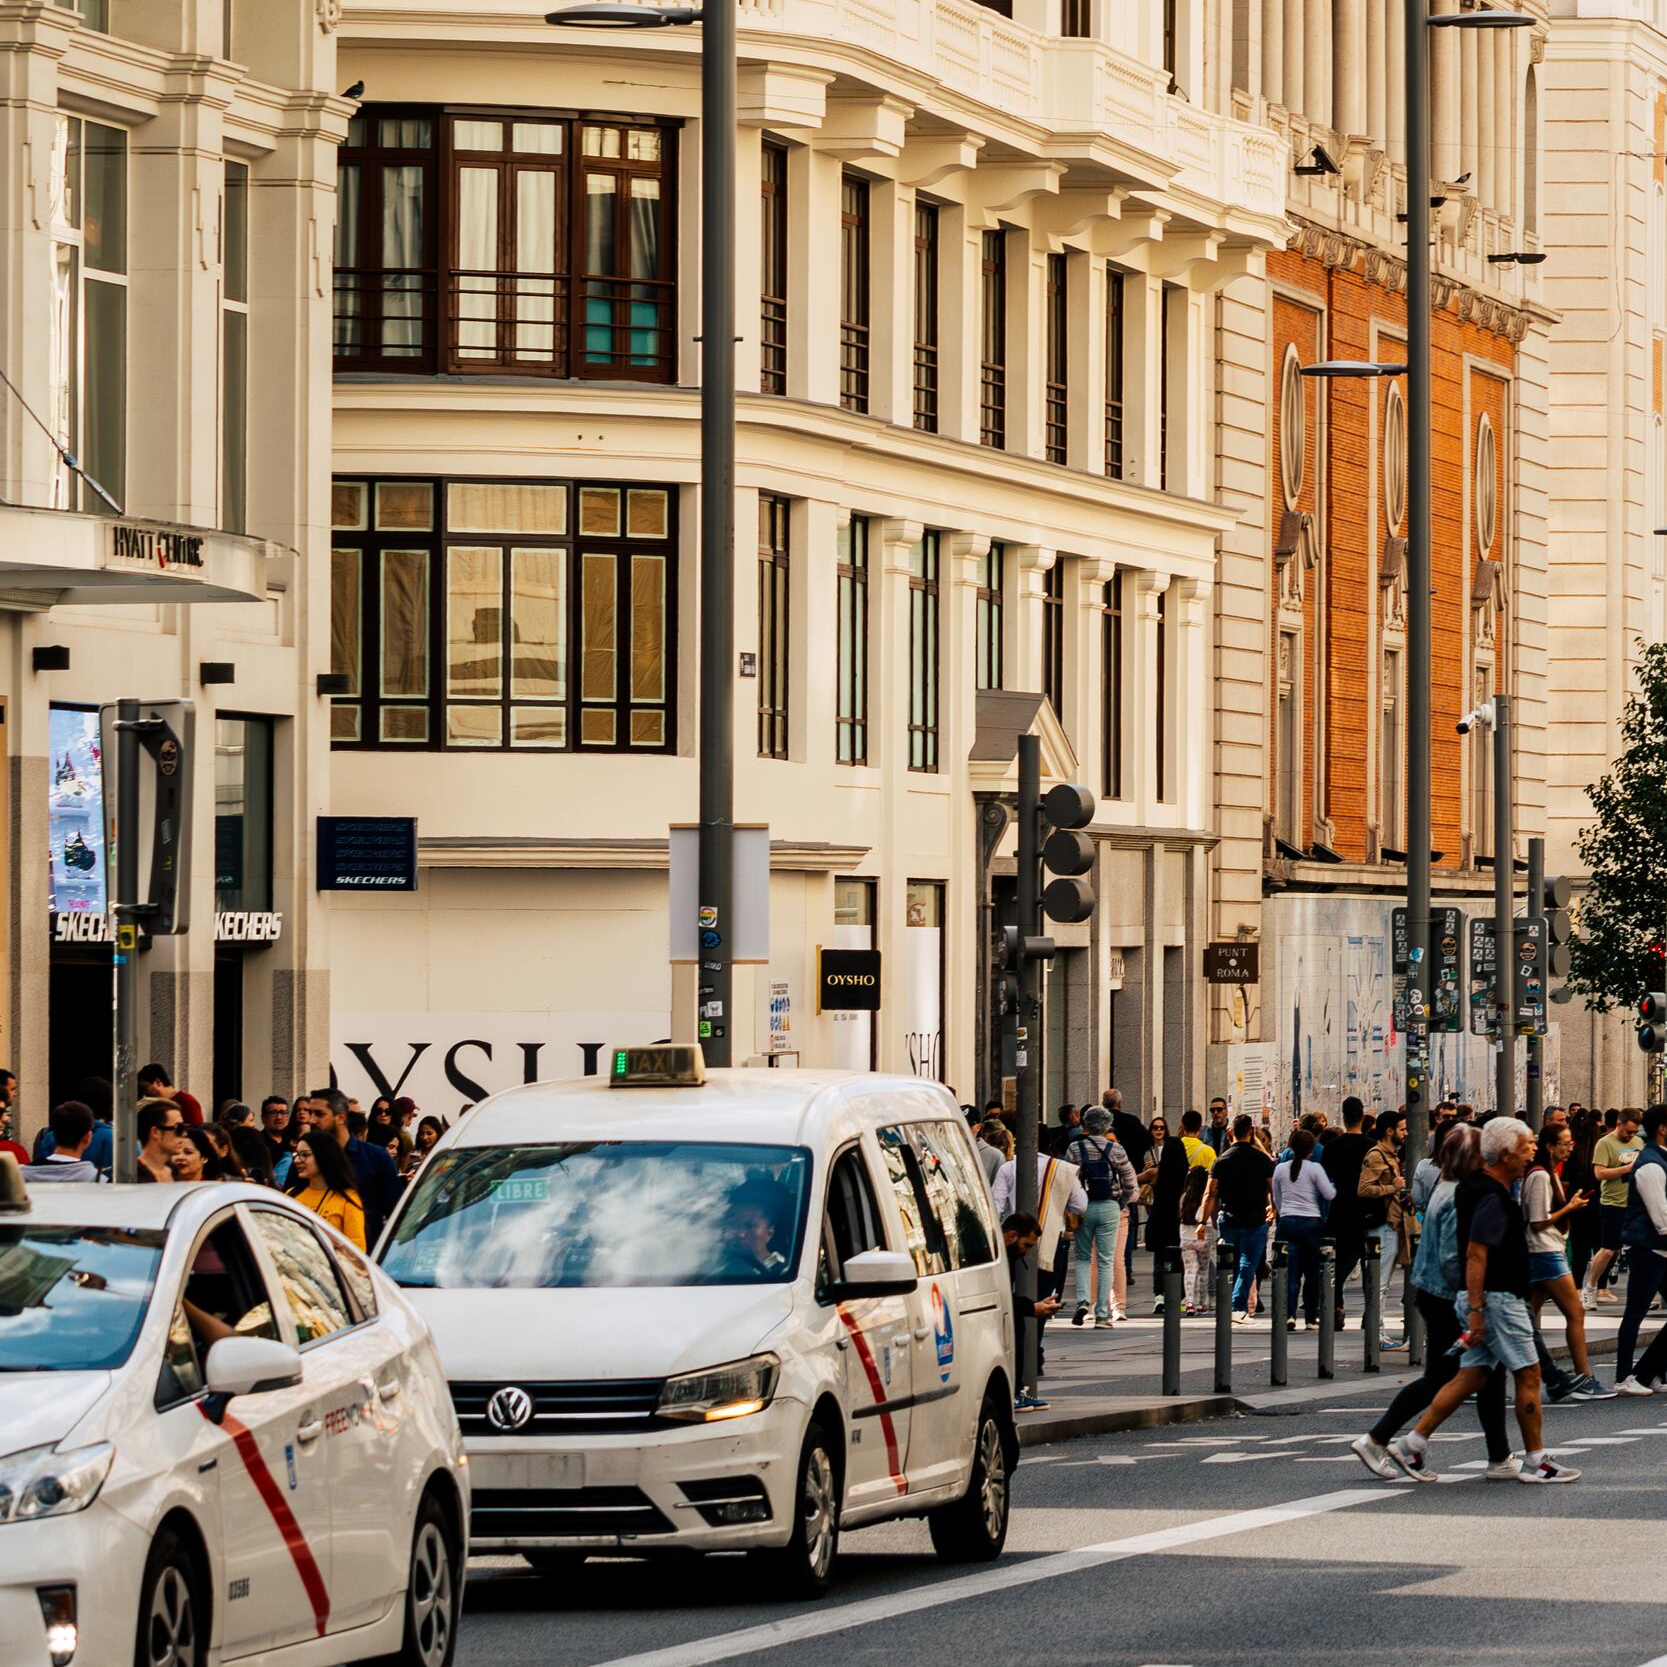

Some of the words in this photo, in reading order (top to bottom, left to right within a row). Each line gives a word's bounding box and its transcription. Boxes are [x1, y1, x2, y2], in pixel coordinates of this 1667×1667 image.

[113, 526, 156, 560] HYATT
[335, 876, 408, 885] SKECHERS
[214, 911, 283, 941] KECHERS
[1218, 947, 1249, 957] PUNT
[827, 974, 875, 986] OYSHO
[1216, 968, 1250, 978] ROMA
[631, 1051, 673, 1072] TAXI
[497, 1182, 545, 1200] LIBRE
